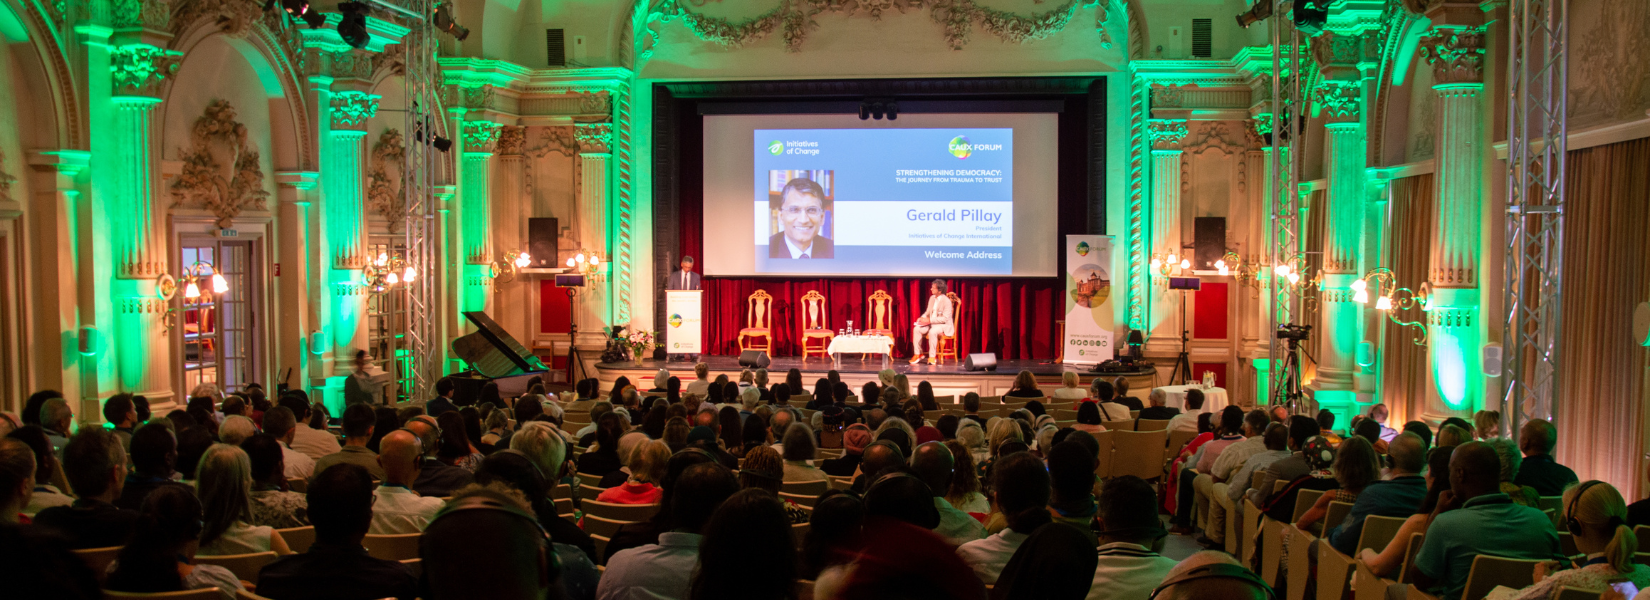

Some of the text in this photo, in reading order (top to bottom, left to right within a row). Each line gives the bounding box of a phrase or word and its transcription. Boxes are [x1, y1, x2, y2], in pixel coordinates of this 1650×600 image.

[794, 148, 820, 156] Change
[906, 208, 1002, 225] Gerald Pillay
[924, 250, 1002, 258] Welcome Address
